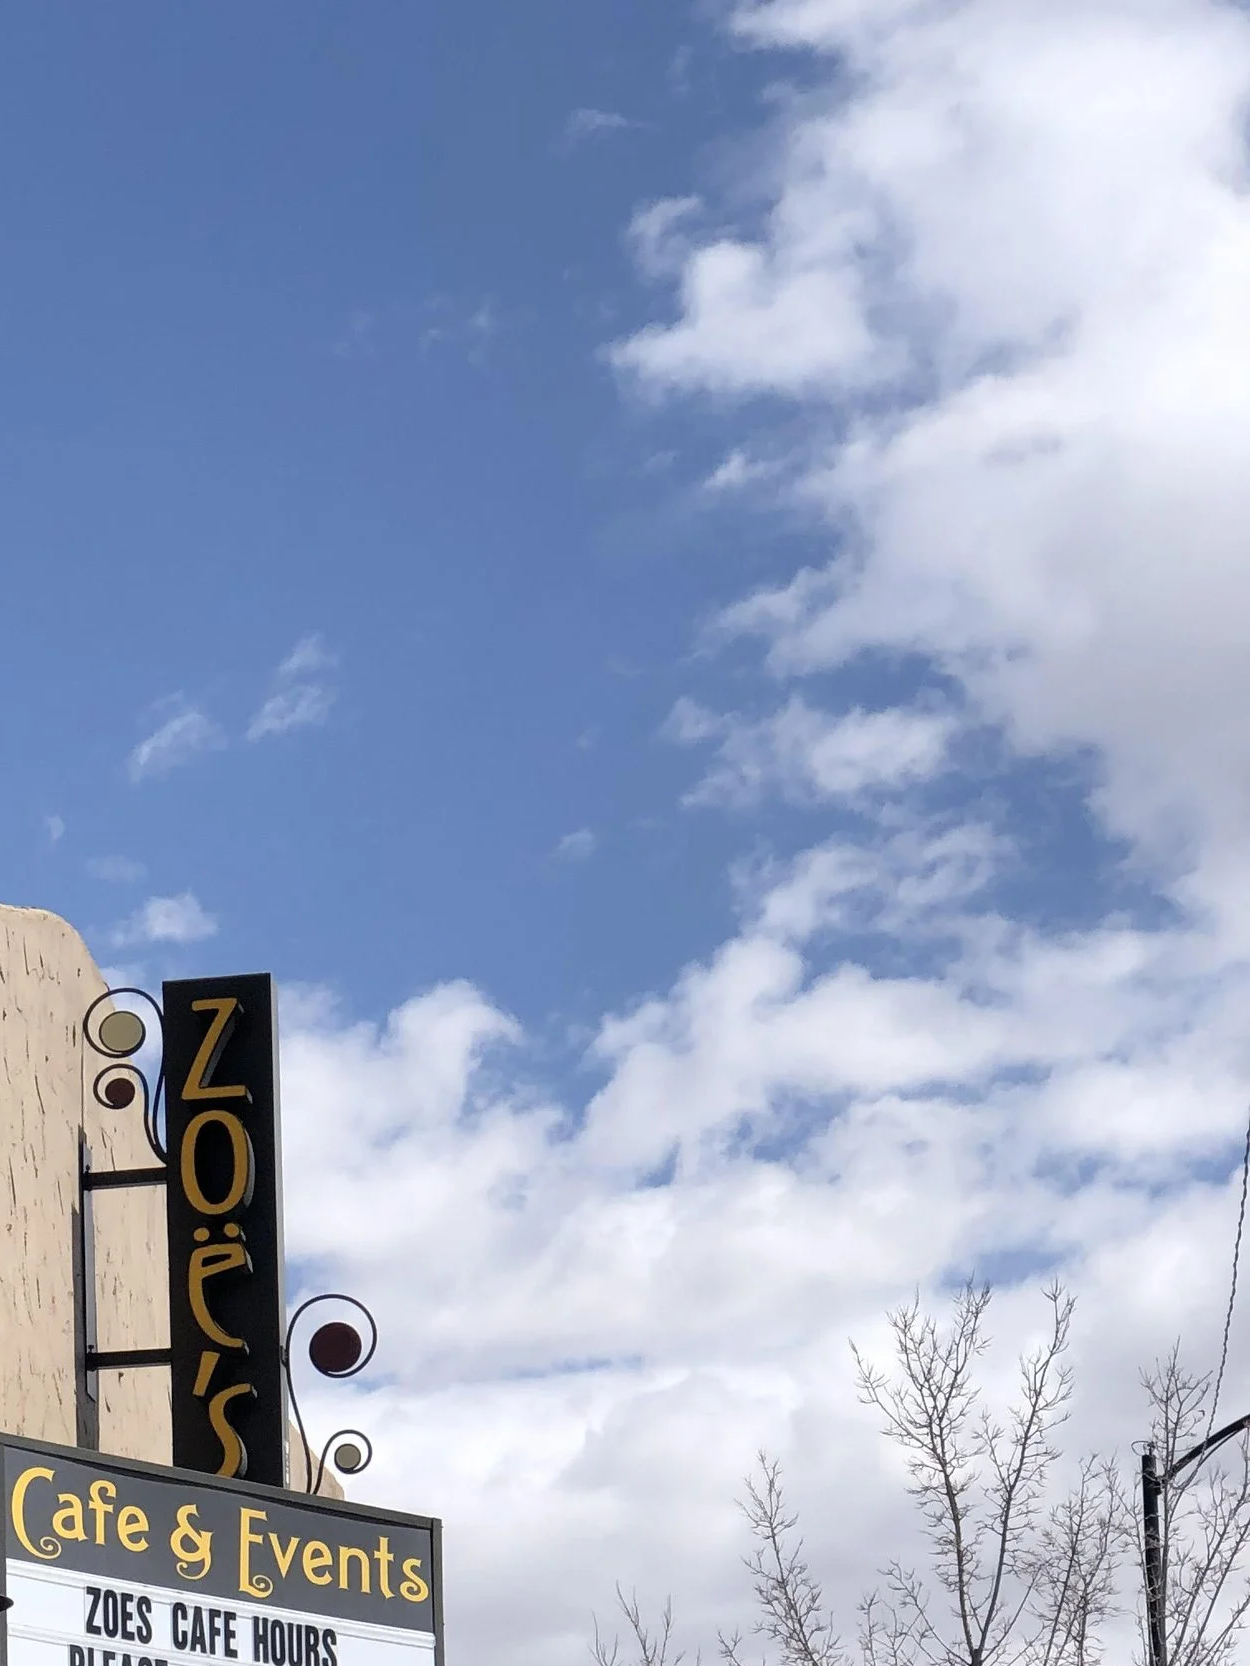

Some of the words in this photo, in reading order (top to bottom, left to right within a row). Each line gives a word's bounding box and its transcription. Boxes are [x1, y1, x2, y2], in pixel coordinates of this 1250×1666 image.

[11, 1466, 150, 1560] Cafe
[170, 1504, 214, 1580] &
[238, 1506, 430, 1603] Events
[85, 1586, 153, 1645] ZOES
[171, 1602, 239, 1659] CAFE
